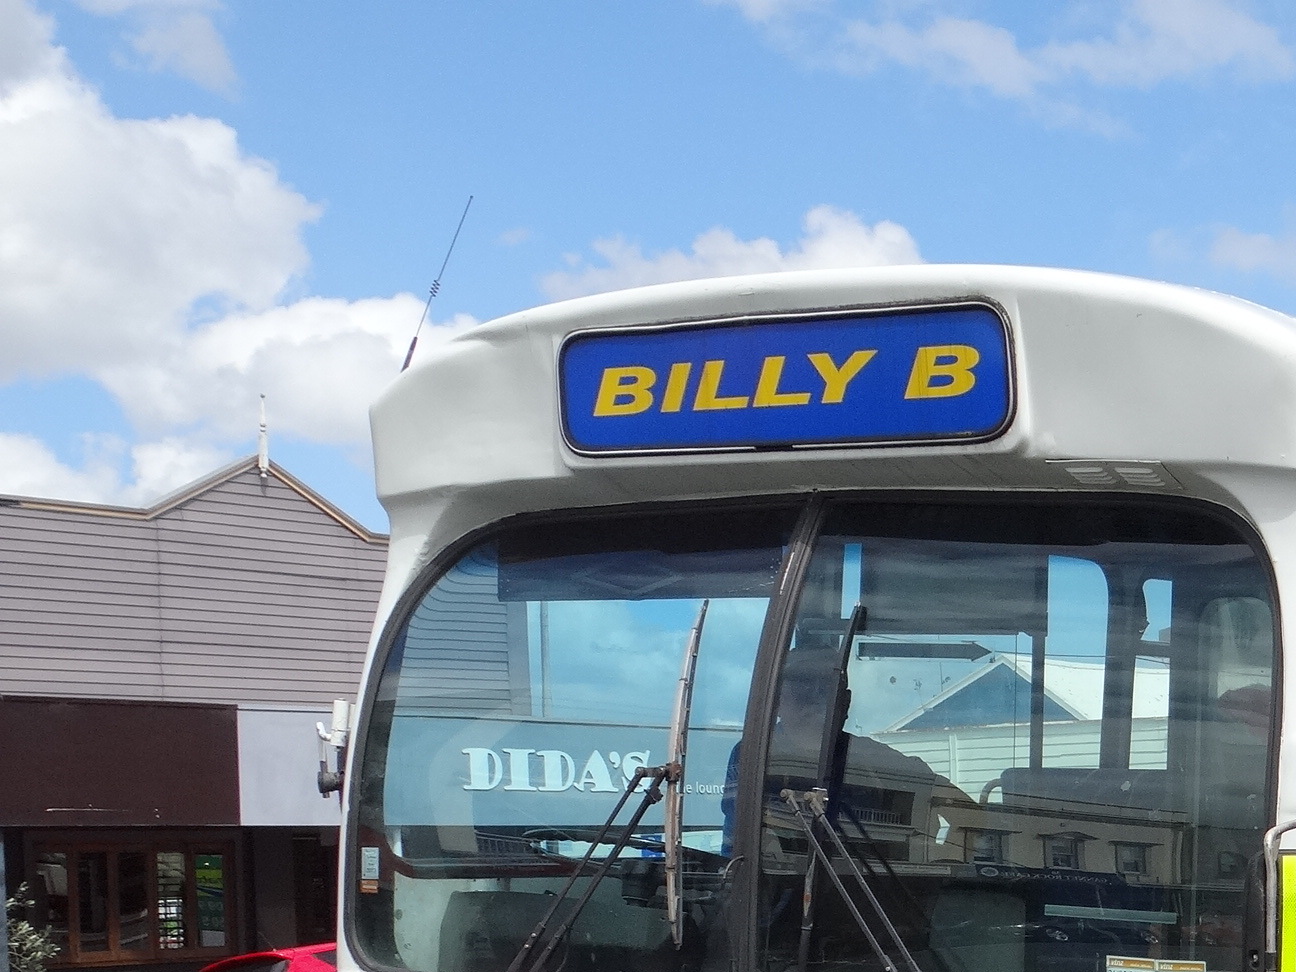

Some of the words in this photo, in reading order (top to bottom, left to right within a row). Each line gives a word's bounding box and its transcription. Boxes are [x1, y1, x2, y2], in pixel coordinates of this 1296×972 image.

[592, 349, 878, 418] BILLY
[903, 344, 981, 400] B
[462, 748, 651, 793] DIDA'S
